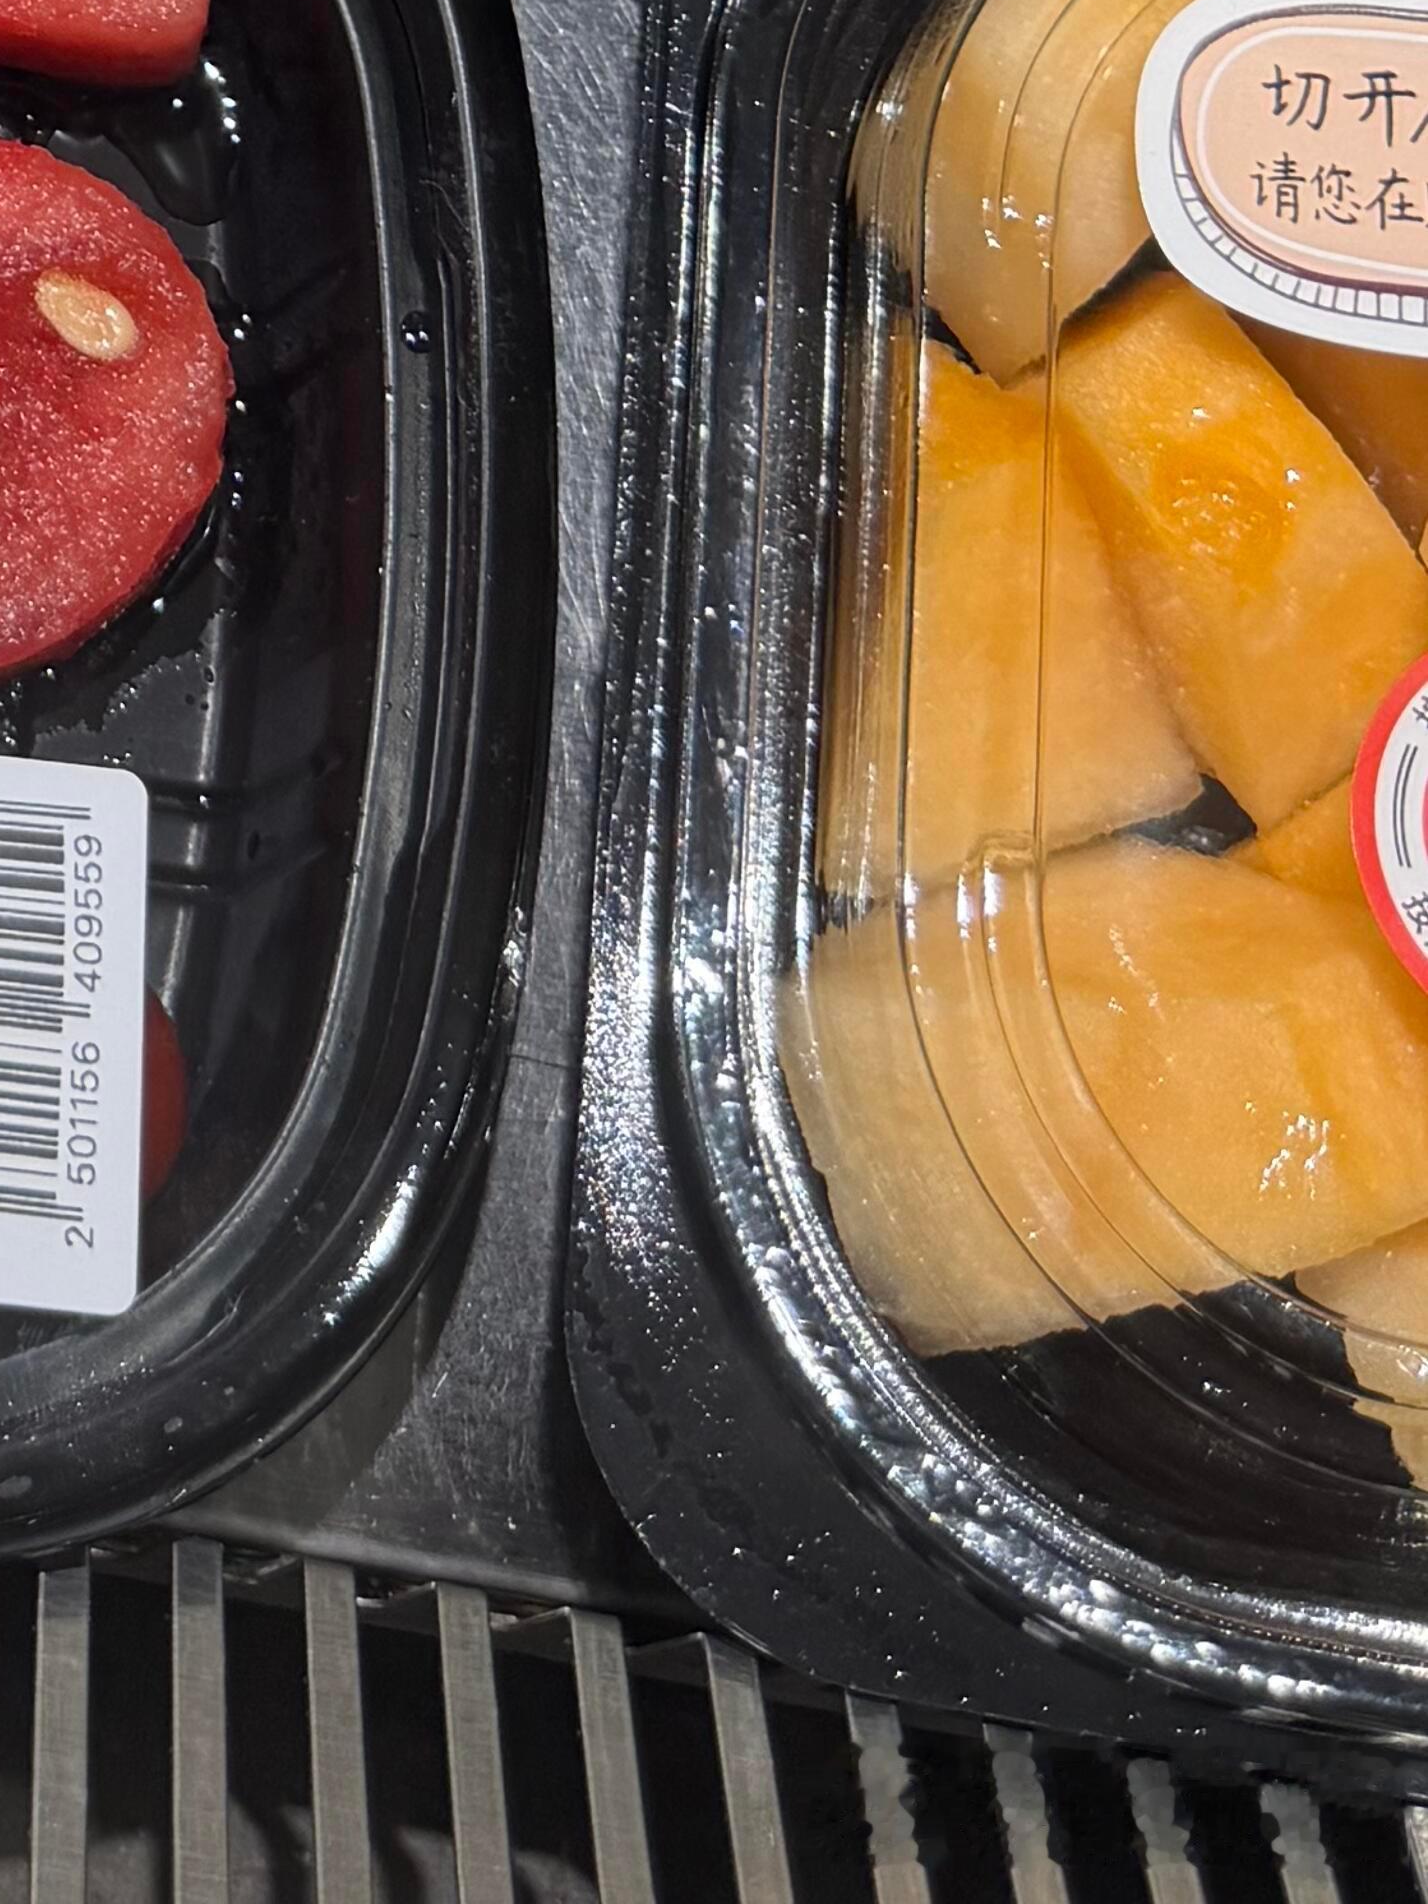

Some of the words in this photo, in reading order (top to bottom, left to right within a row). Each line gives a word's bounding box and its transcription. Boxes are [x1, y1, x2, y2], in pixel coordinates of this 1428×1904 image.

[1262, 64, 1428, 148] 切开
[1250, 151, 1428, 232] 请您在
[72, 833, 104, 993] 409559
[66, 1040, 101, 1186] 501156
[64, 1225, 95, 1248] 2
